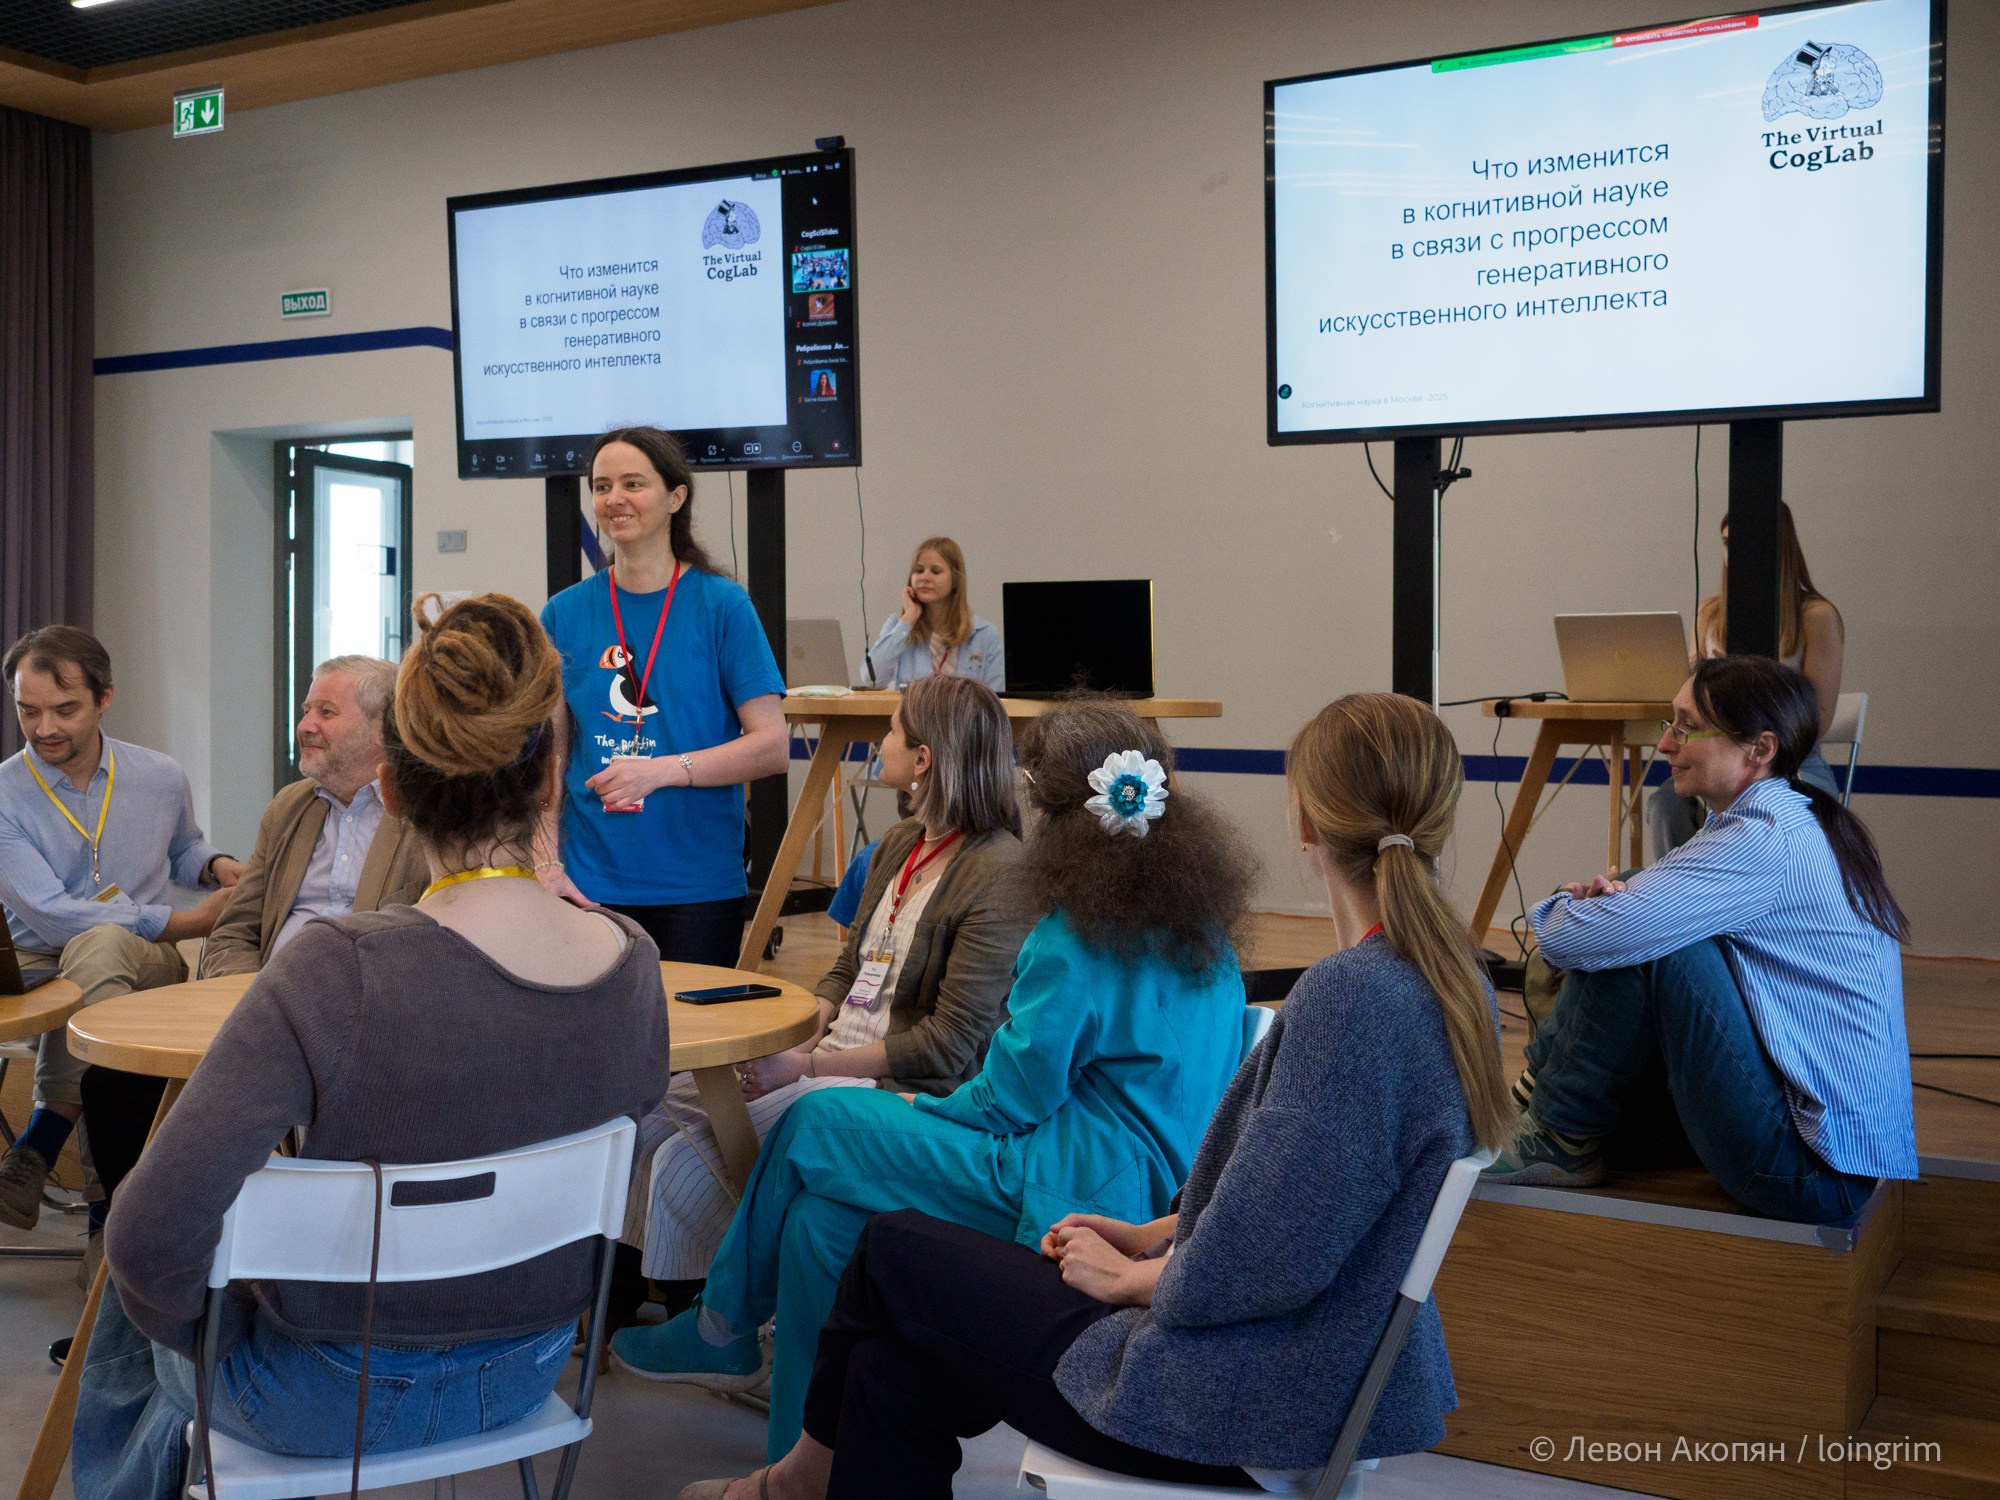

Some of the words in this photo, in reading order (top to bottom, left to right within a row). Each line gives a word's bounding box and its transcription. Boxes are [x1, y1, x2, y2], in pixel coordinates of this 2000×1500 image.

[1761, 131, 1801, 148] The
[1806, 119, 1883, 142] Virtual
[1472, 159, 1518, 181] Что
[1528, 143, 1669, 176] изменится
[1769, 140, 1874, 172] CogLab
[1403, 207, 1416, 224] в
[1425, 184, 1582, 222] когнитивной
[1593, 179, 1668, 206] науке
[801, 228, 839, 238] CogSciSlides
[1392, 242, 1404, 259] в
[1412, 236, 1481, 257] связи
[1490, 232, 1503, 250] с
[1513, 216, 1668, 252] прогрессом
[559, 265, 583, 279] Что
[587, 260, 659, 277] изменится
[703, 256, 723, 266] The
[725, 251, 762, 263] Virtual
[1477, 252, 1669, 286] генеративного
[707, 264, 758, 282] CogLab
[283, 294, 326, 312] ВЫХОД
[525, 295, 532, 305] в
[536, 284, 616, 305] когнитивной
[621, 283, 659, 300] науке
[520, 317, 527, 328] в
[531, 314, 566, 328] связи
[570, 313, 578, 324] с
[582, 305, 660, 326] прогрессом
[1319, 300, 1507, 336] искусственного
[1516, 287, 1668, 318] интеллекта
[564, 329, 661, 351] генеративного
[484, 358, 581, 378] искусственного
[585, 352, 661, 369] интеллекта
[1302, 400, 1355, 409] Когнитивная
[594, 734, 615, 747] The
